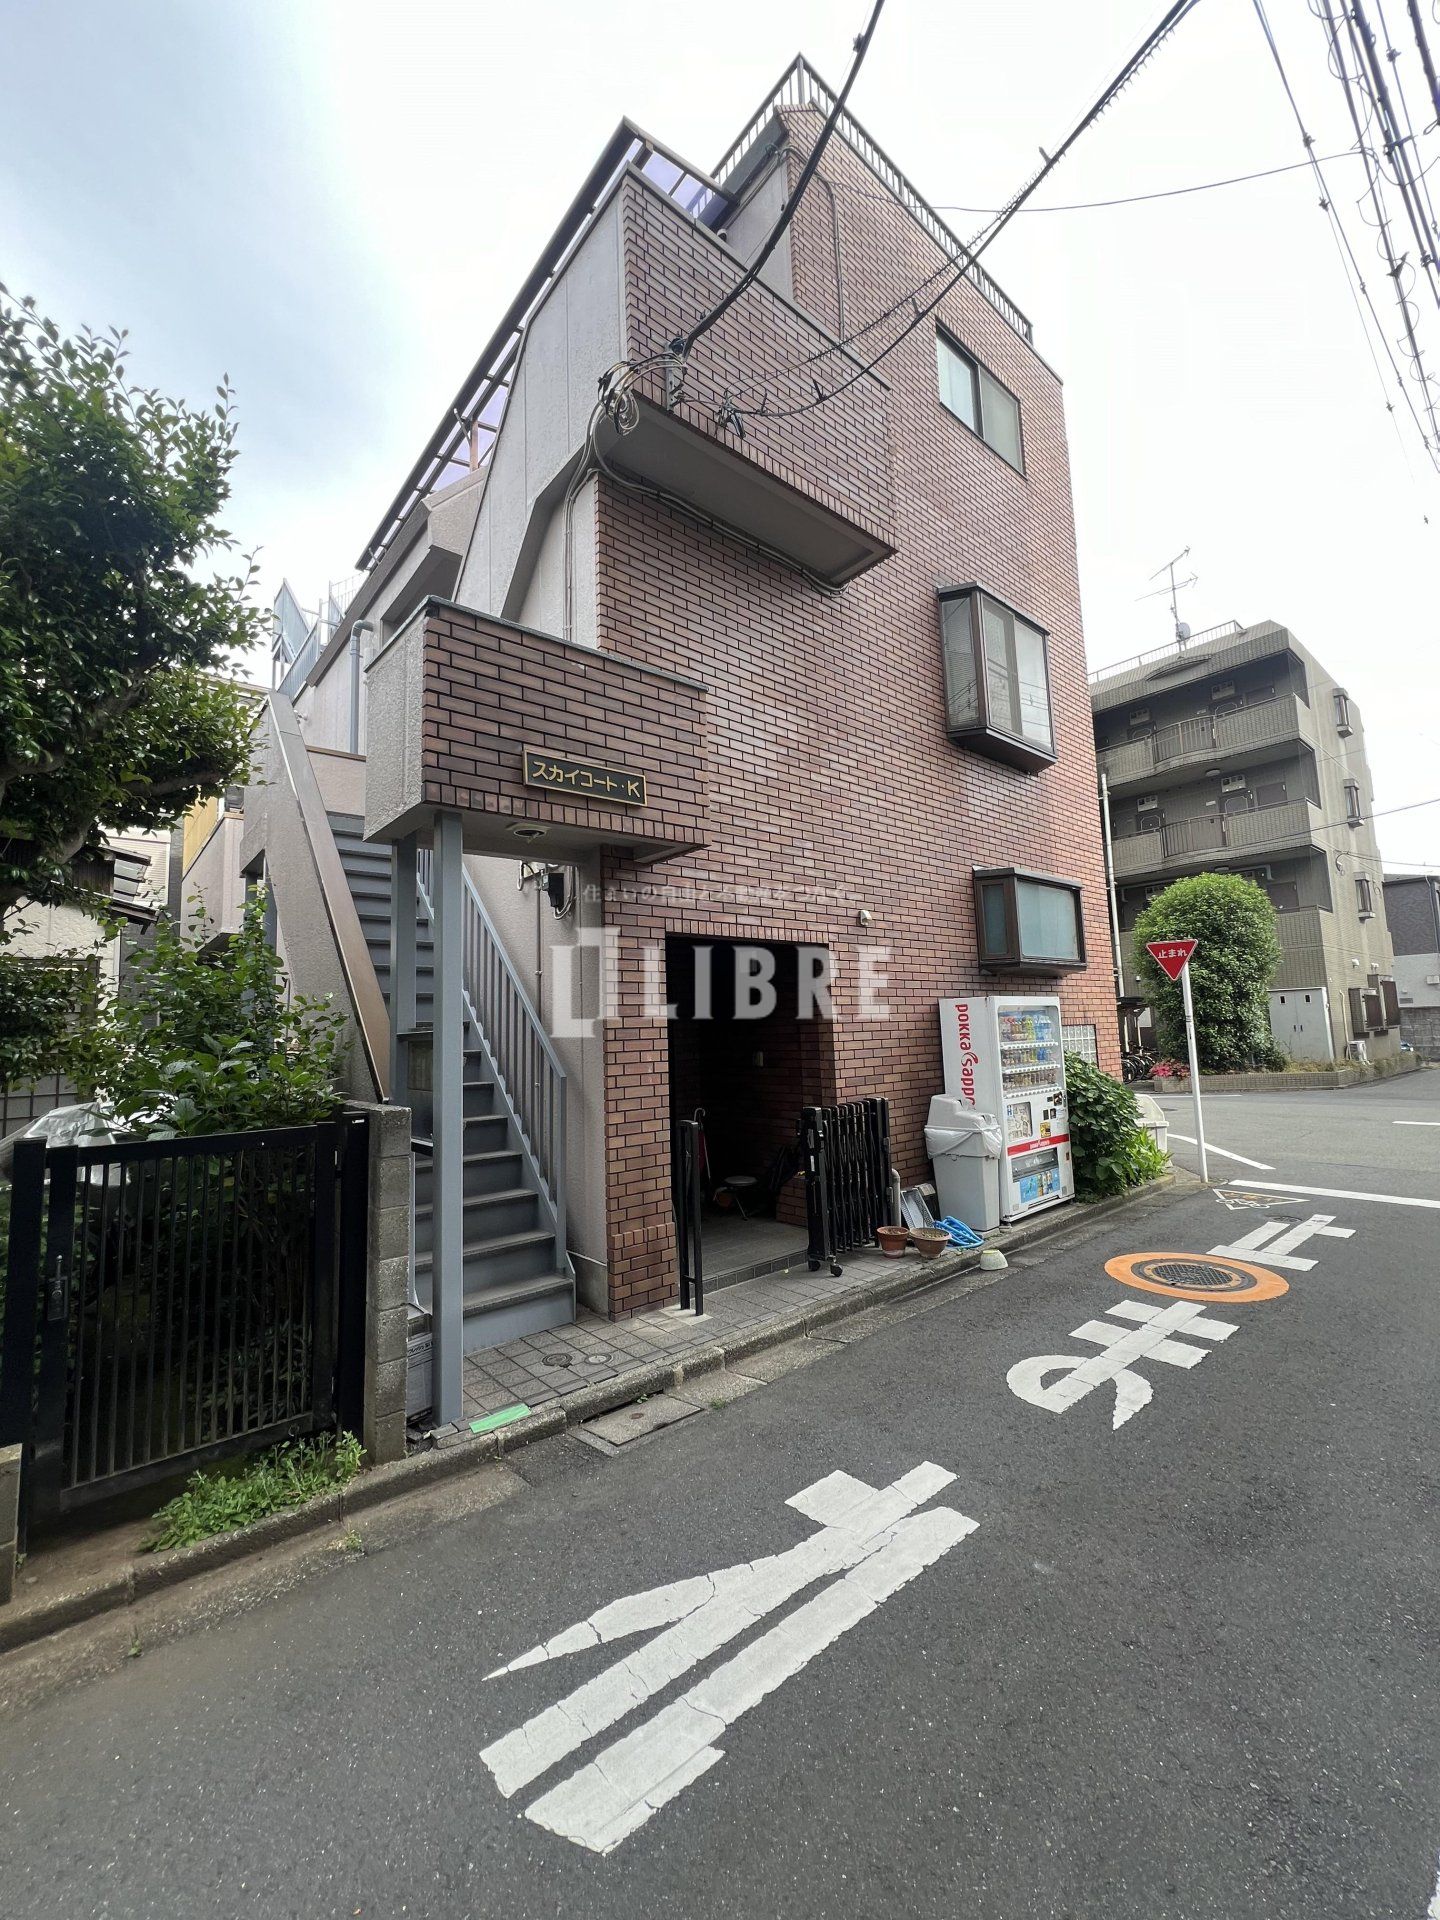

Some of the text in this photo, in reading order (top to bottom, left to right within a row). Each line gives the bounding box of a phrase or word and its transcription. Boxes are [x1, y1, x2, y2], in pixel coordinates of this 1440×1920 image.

[532, 760, 641, 798] スカイコート・K
[1157, 948, 1188, 959] 止まれ
